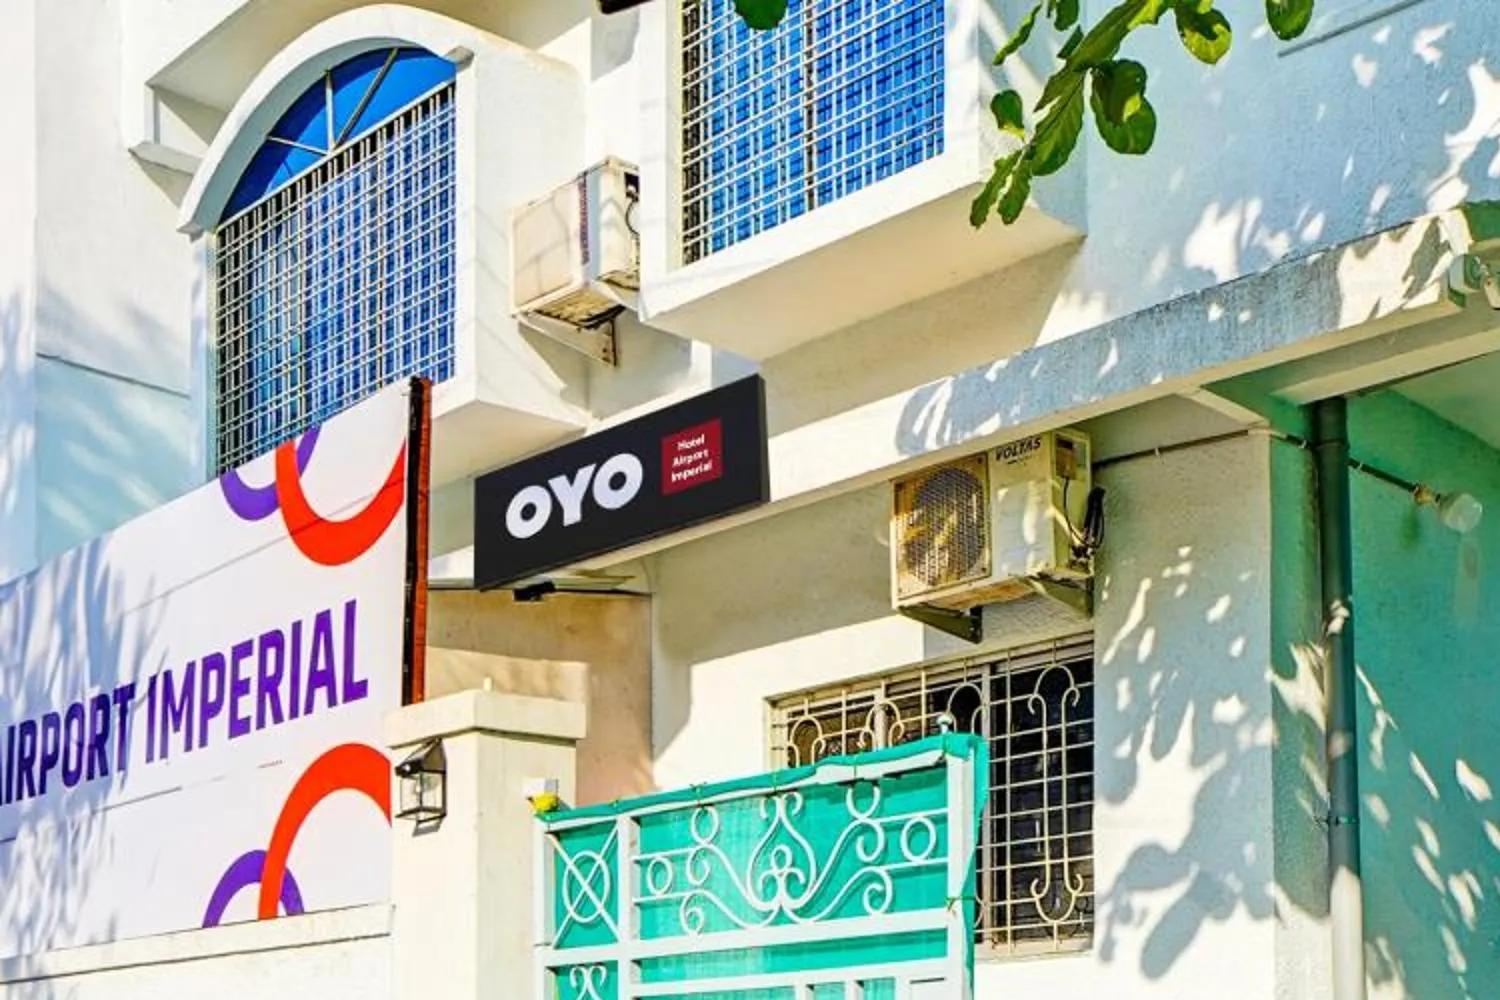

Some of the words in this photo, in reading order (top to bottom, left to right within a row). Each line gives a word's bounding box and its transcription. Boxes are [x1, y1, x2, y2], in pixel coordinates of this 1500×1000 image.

[677, 433, 705, 451] Hotel
[995, 436, 1041, 461] VOLTAS
[672, 449, 709, 468] Airport
[671, 460, 713, 483] Imperial
[505, 452, 644, 540] OYO
[0, 682, 136, 806] IRPORT
[145, 598, 369, 765] IMPERIAL
